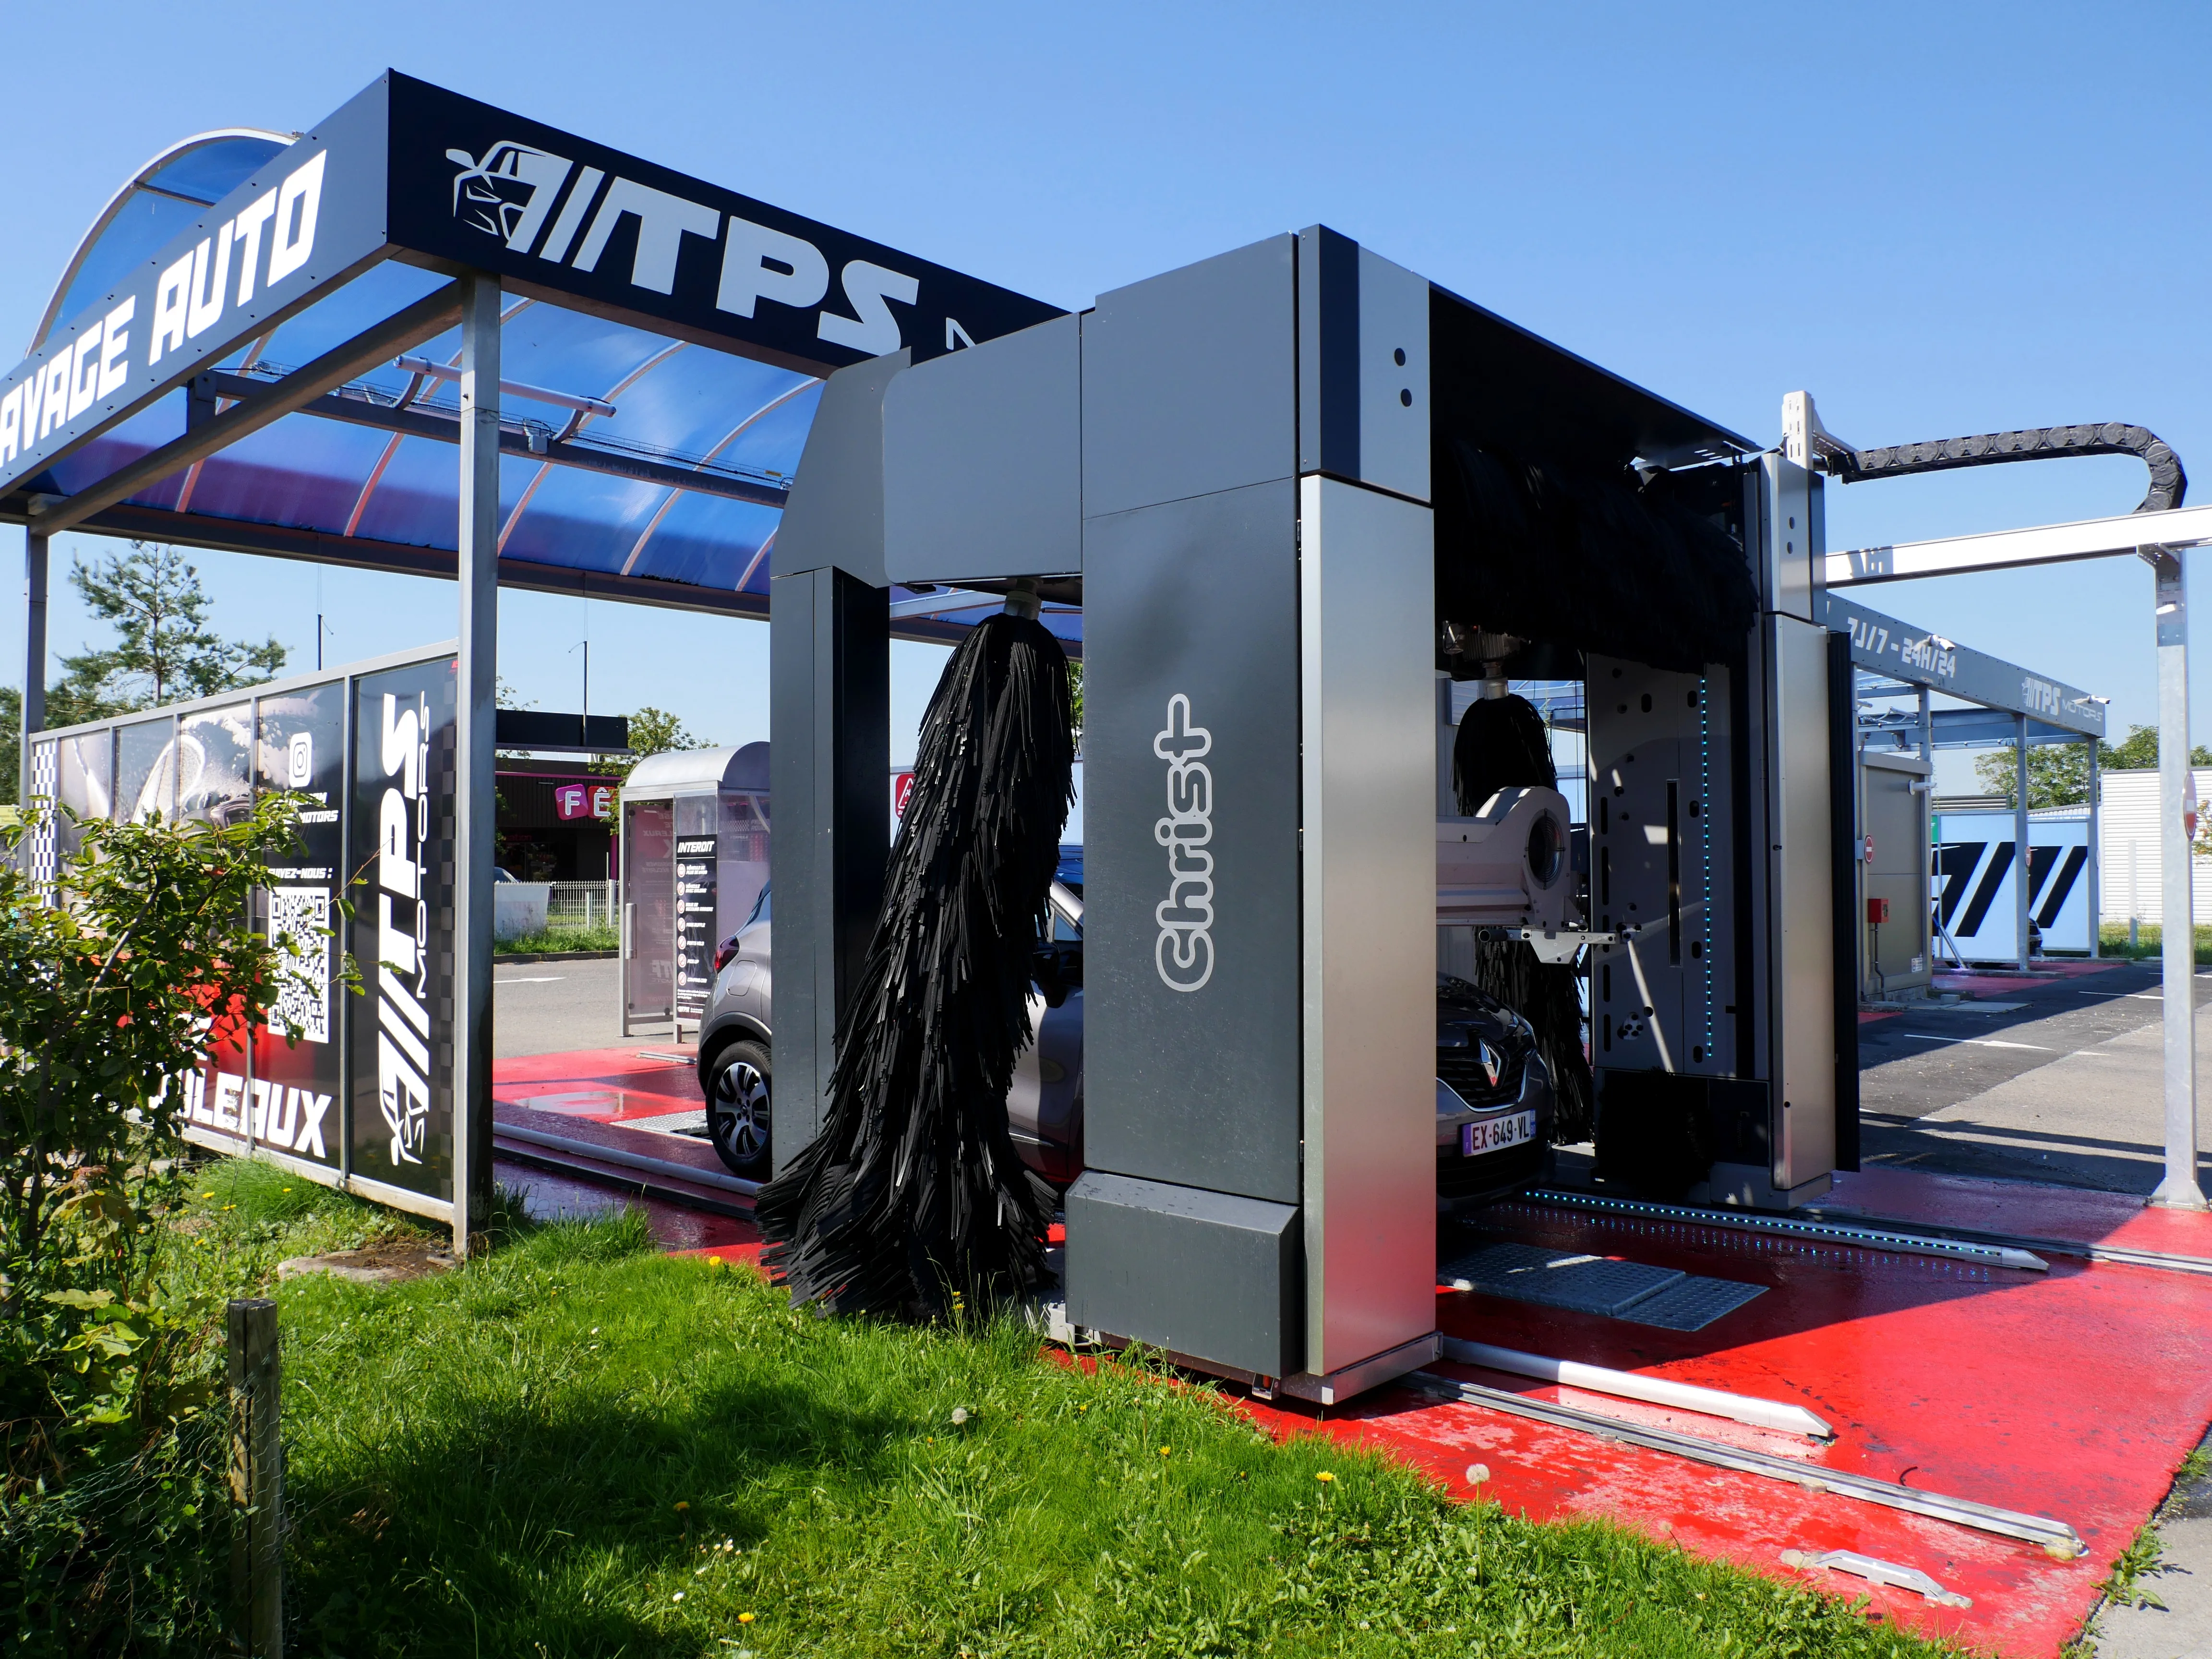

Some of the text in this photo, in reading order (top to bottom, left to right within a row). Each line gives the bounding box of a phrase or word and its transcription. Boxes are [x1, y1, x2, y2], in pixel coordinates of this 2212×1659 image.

[149, 149, 327, 366] AUTO
[1847, 616, 1888, 654] 7J/7
[2062, 698, 2103, 722] MOTORS
[416, 690, 430, 999] MOTORS
[677, 841, 715, 853] INTERDIT
[1154, 693, 1214, 992] Christ
[1472, 1116, 1529, 1151] EX-649-VL
